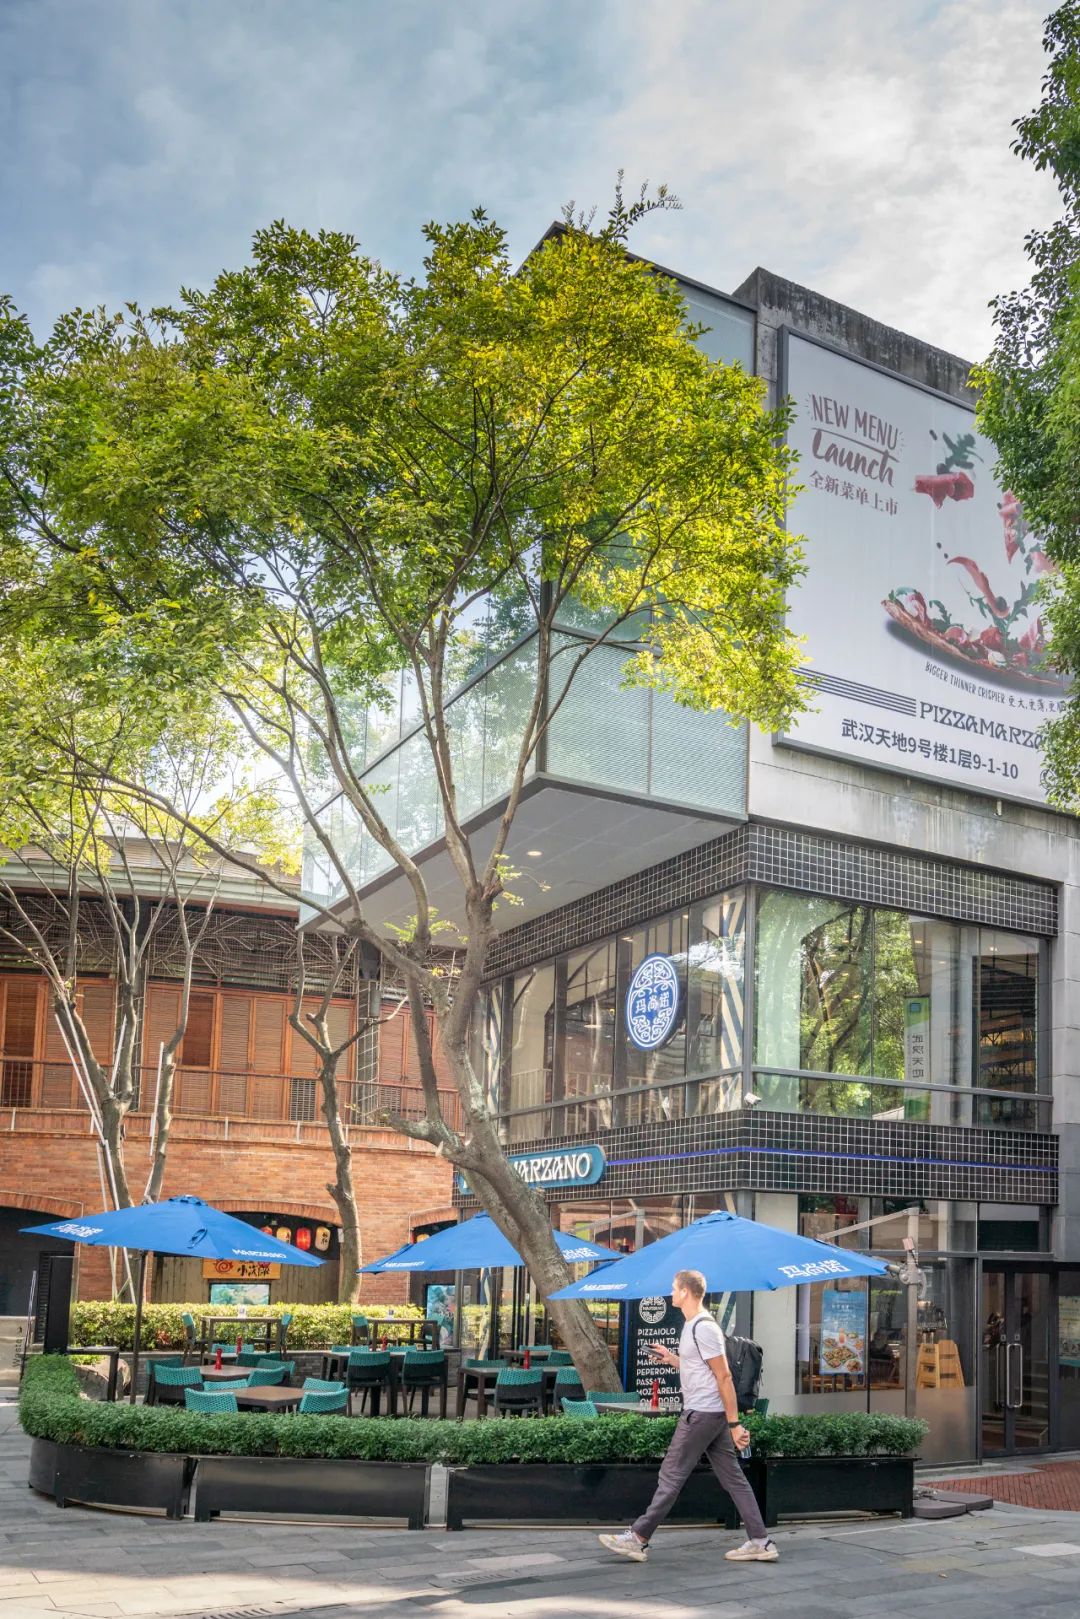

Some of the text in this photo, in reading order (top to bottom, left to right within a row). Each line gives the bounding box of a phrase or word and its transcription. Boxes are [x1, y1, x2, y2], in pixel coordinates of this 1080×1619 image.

[812, 394, 899, 450] NEW MENU
[812, 428, 894, 487] Launch
[810, 470, 898, 516] 全新菜单上市
[925, 661, 1005, 704] BIGGER THINNER CRISPIER
[841, 718, 1019, 780] 武汉天地9号楼1层9-1-10
[513, 1152, 592, 1183] ARZANO
[637, 1327, 676, 1336] PIZZAIOLO
[637, 1338, 665, 1346] ITALIAN
[636, 1386, 683, 1396] MOZARELLA
